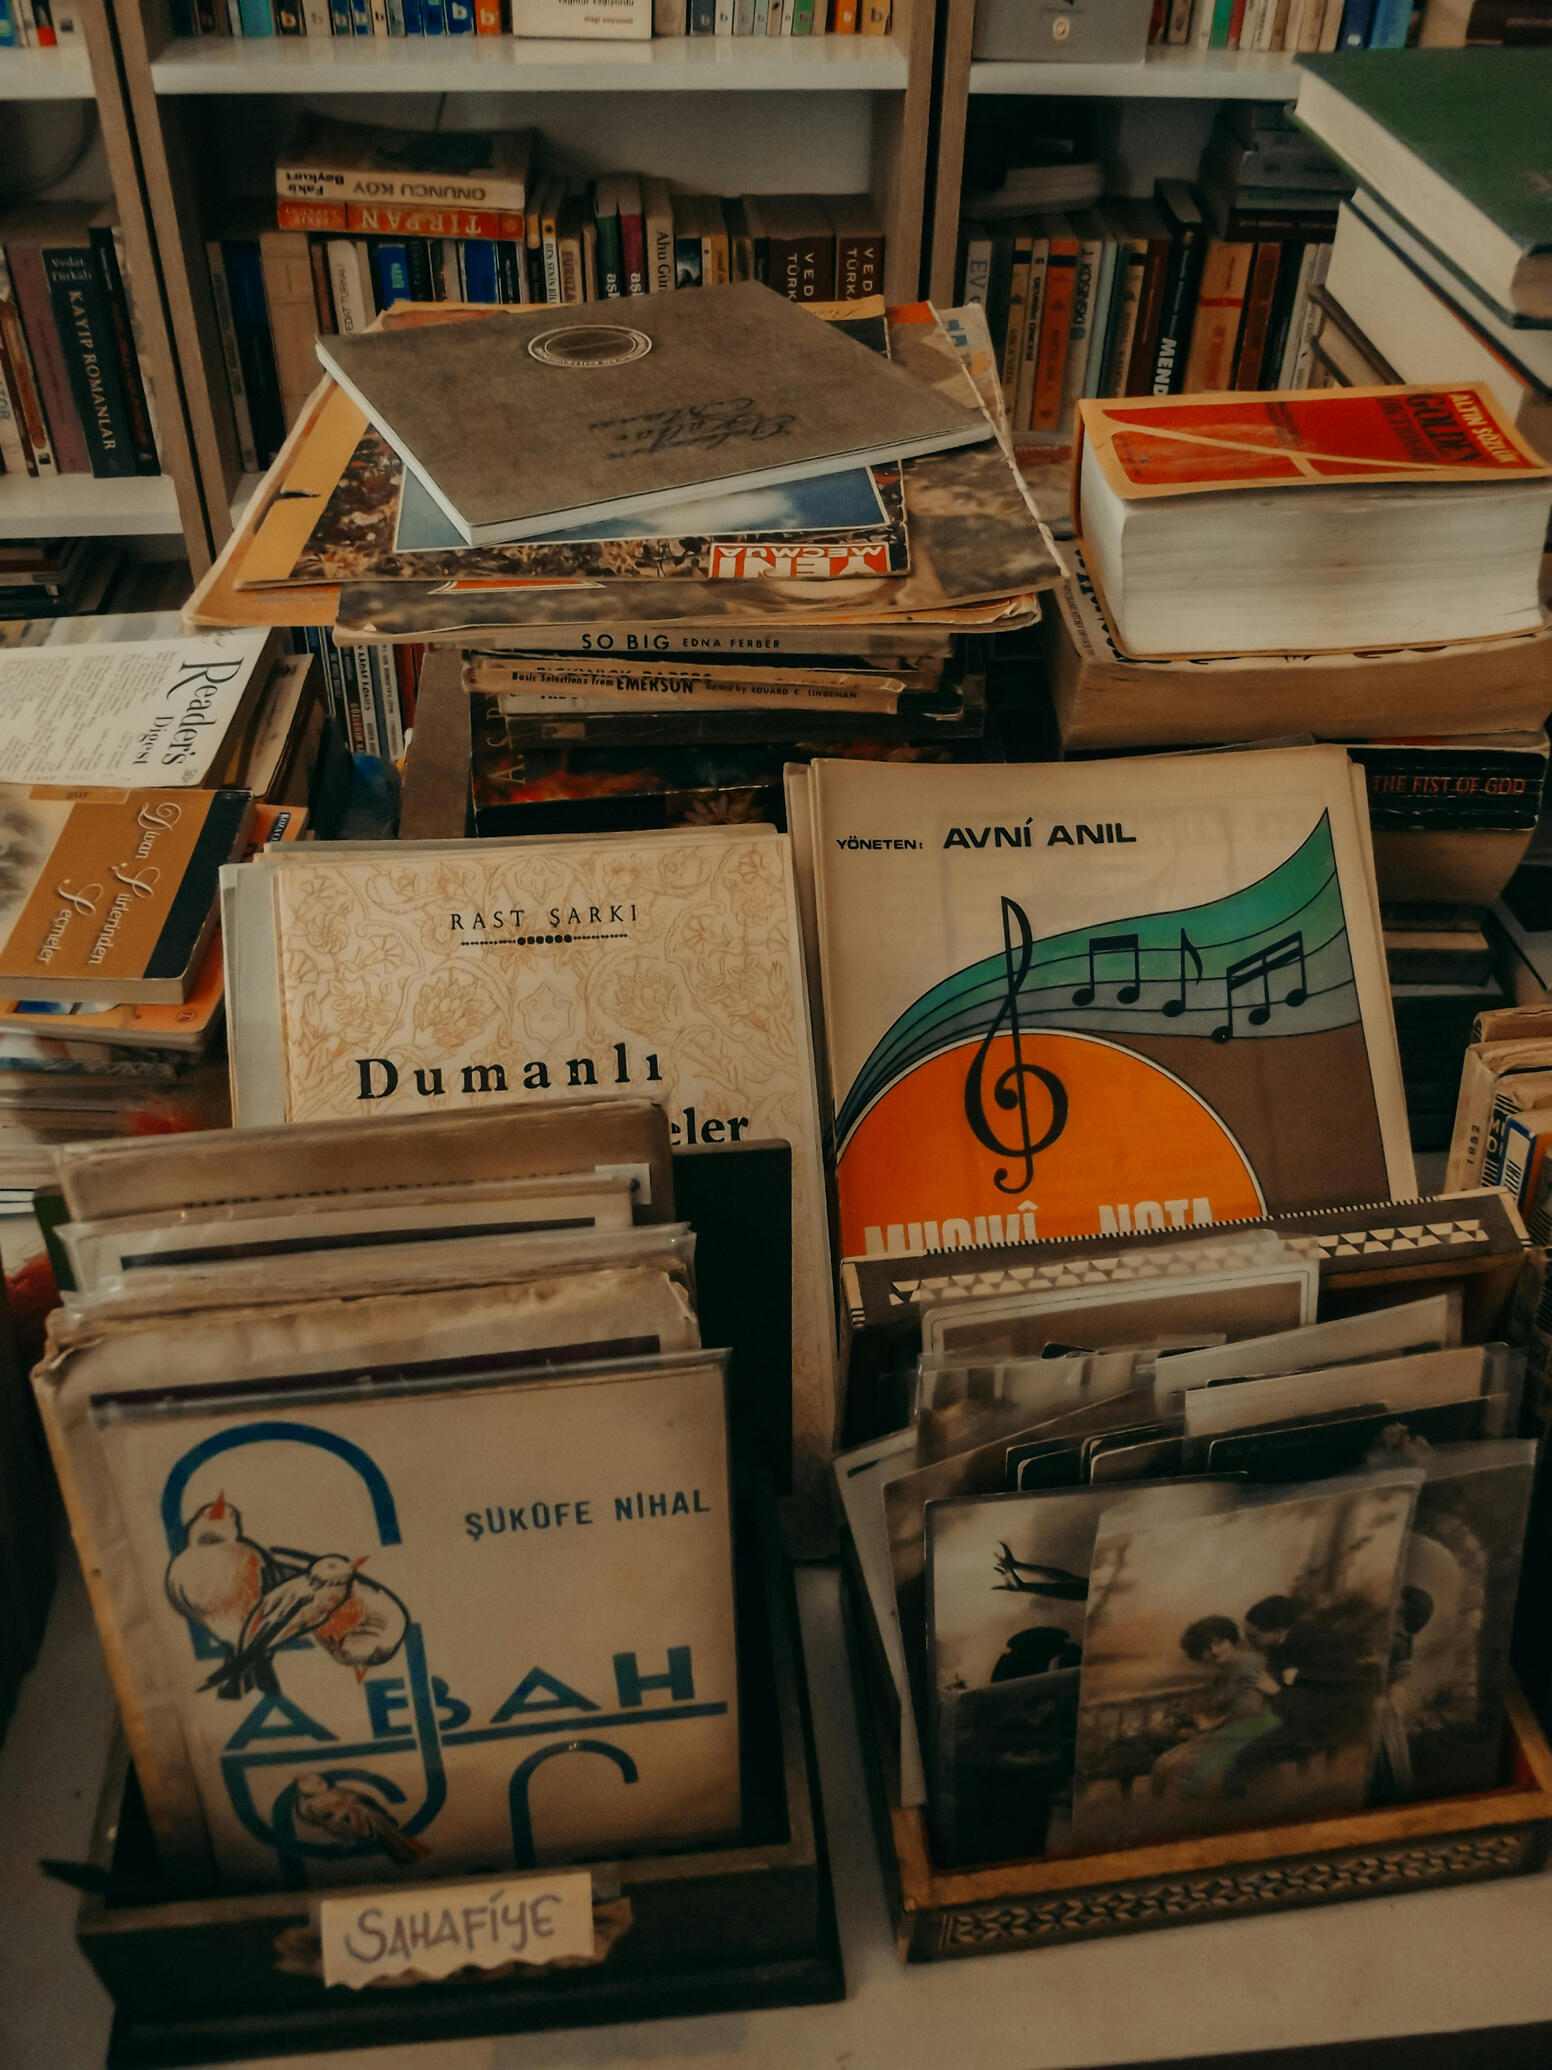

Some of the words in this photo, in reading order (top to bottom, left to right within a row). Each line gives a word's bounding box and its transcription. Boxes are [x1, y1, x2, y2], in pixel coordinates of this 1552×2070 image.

[400, 183, 487, 201] ONUNCU
[656, 230, 671, 261] Ahu
[69, 290, 95, 350] KAYIP
[82, 352, 117, 451] ROMANLAR
[717, 545, 883, 558] MECMUA
[581, 633, 614, 650] SO
[626, 633, 670, 650] BIG
[682, 637, 721, 648] EDNA
[729, 638, 780, 649] FERBER
[511, 671, 536, 682] Basic
[540, 672, 588, 685] Selections
[591, 675, 614, 687] from
[616, 676, 694, 694] EMERSON
[161, 656, 245, 766] Reader's
[132, 716, 175, 766] Digest
[1373, 775, 1408, 793] THE
[1411, 775, 1453, 794] FIST
[1456, 776, 1481, 794] OF
[1484, 777, 1527, 796] GOD
[835, 836, 924, 851] YÖNETEN:
[1046, 822, 1137, 846] ANIL
[450, 908, 526, 931] RAST
[549, 903, 639, 929] ŞARKI
[356, 1042, 663, 1101] Dumanlı
[614, 1488, 711, 1522] NİHAL
